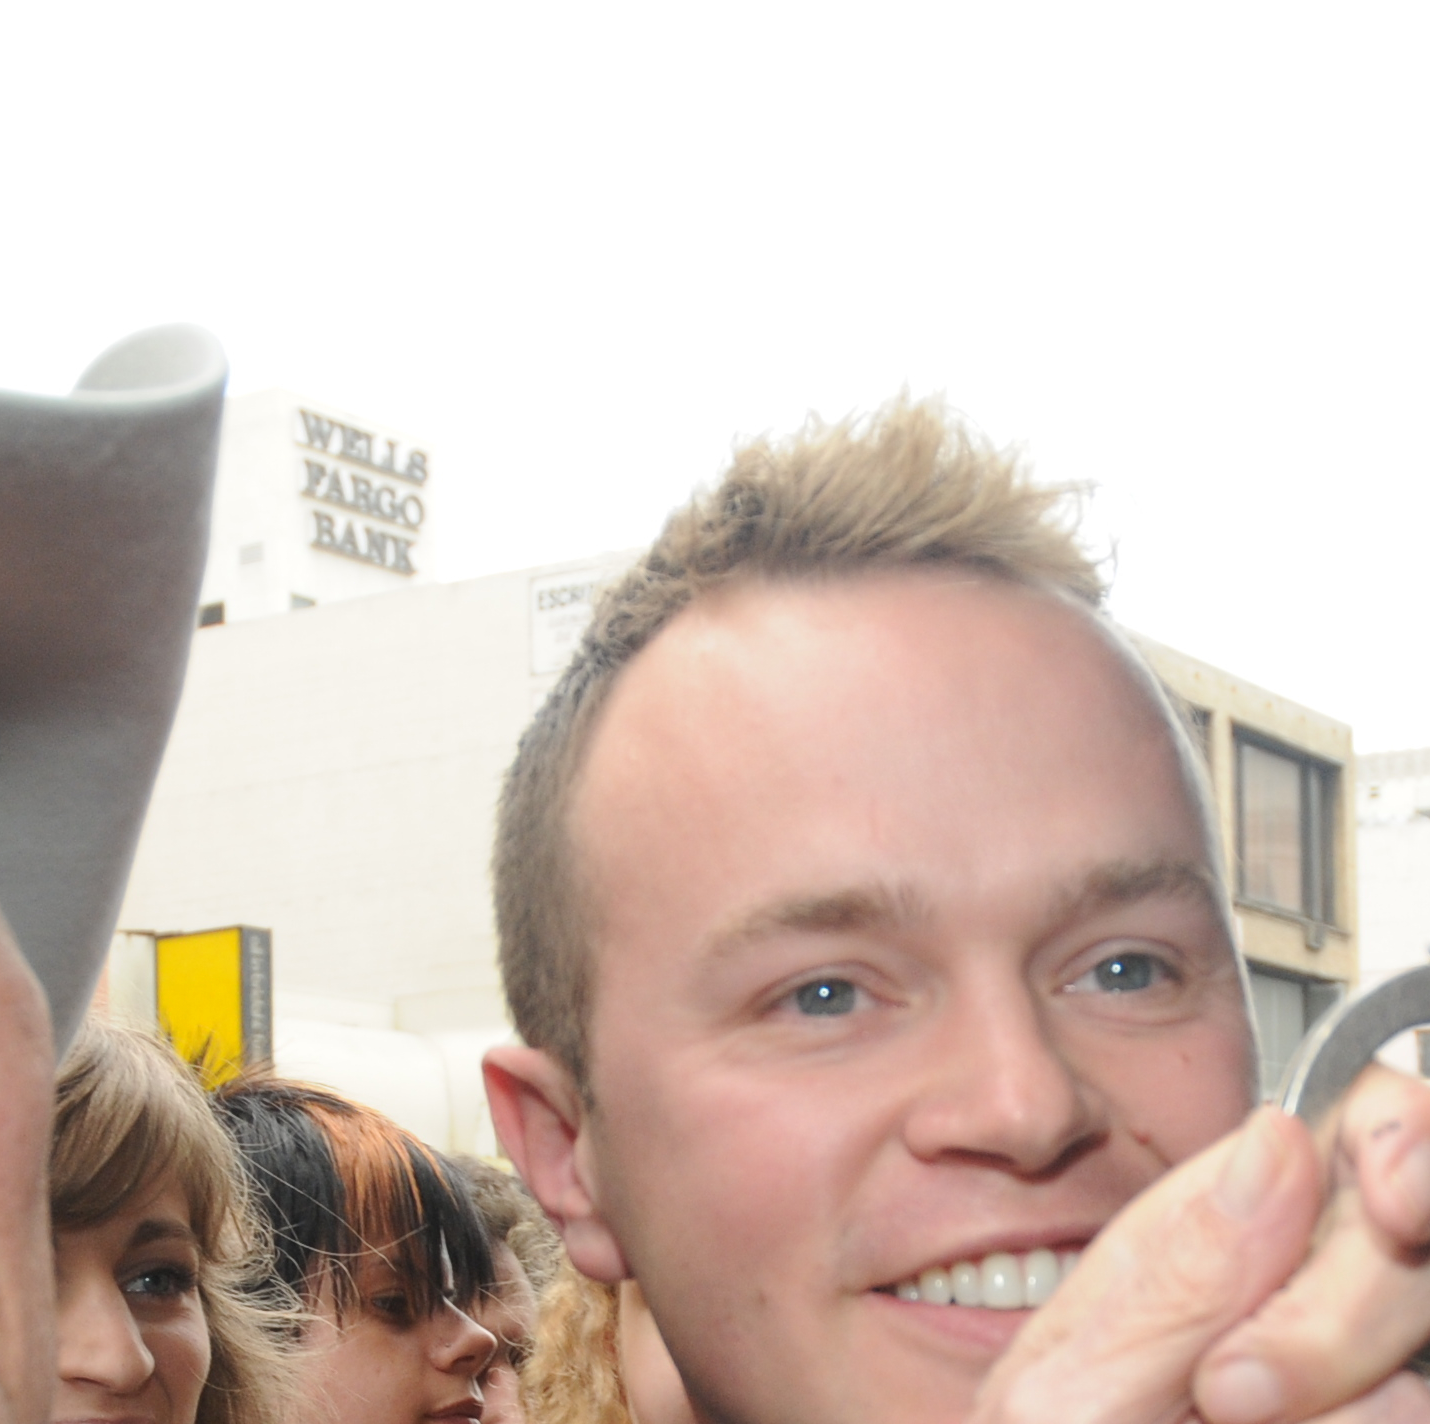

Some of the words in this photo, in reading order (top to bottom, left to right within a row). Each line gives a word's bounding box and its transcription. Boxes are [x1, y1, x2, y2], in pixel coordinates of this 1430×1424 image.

[295, 407, 429, 487] WELLS
[300, 459, 425, 531] FARGO
[310, 510, 418, 577] BANK
